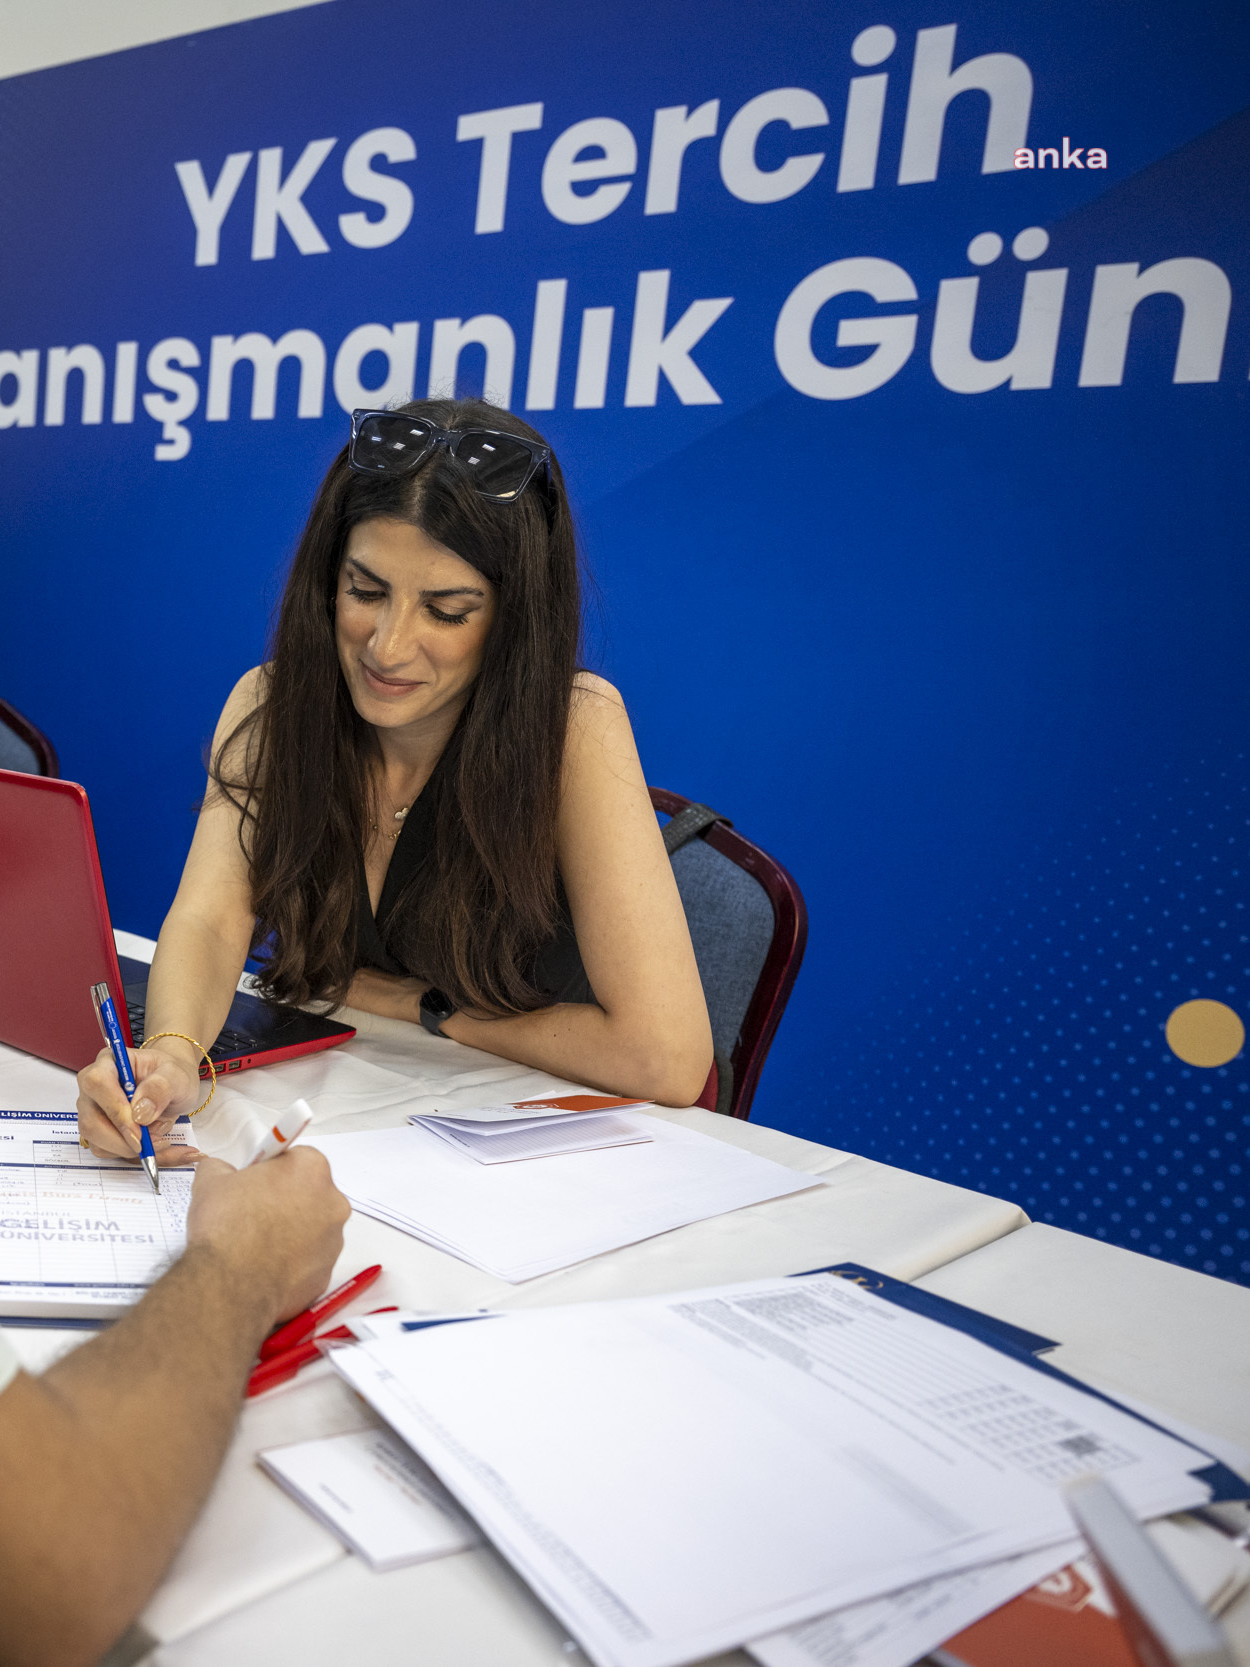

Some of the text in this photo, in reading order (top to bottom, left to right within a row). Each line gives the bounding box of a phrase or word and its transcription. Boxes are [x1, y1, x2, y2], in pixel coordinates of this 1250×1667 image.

[174, 23, 1034, 268] YKS Tercih
[774, 226, 1250, 401] Gün
[0, 1217, 121, 1232] GELİŞİM
